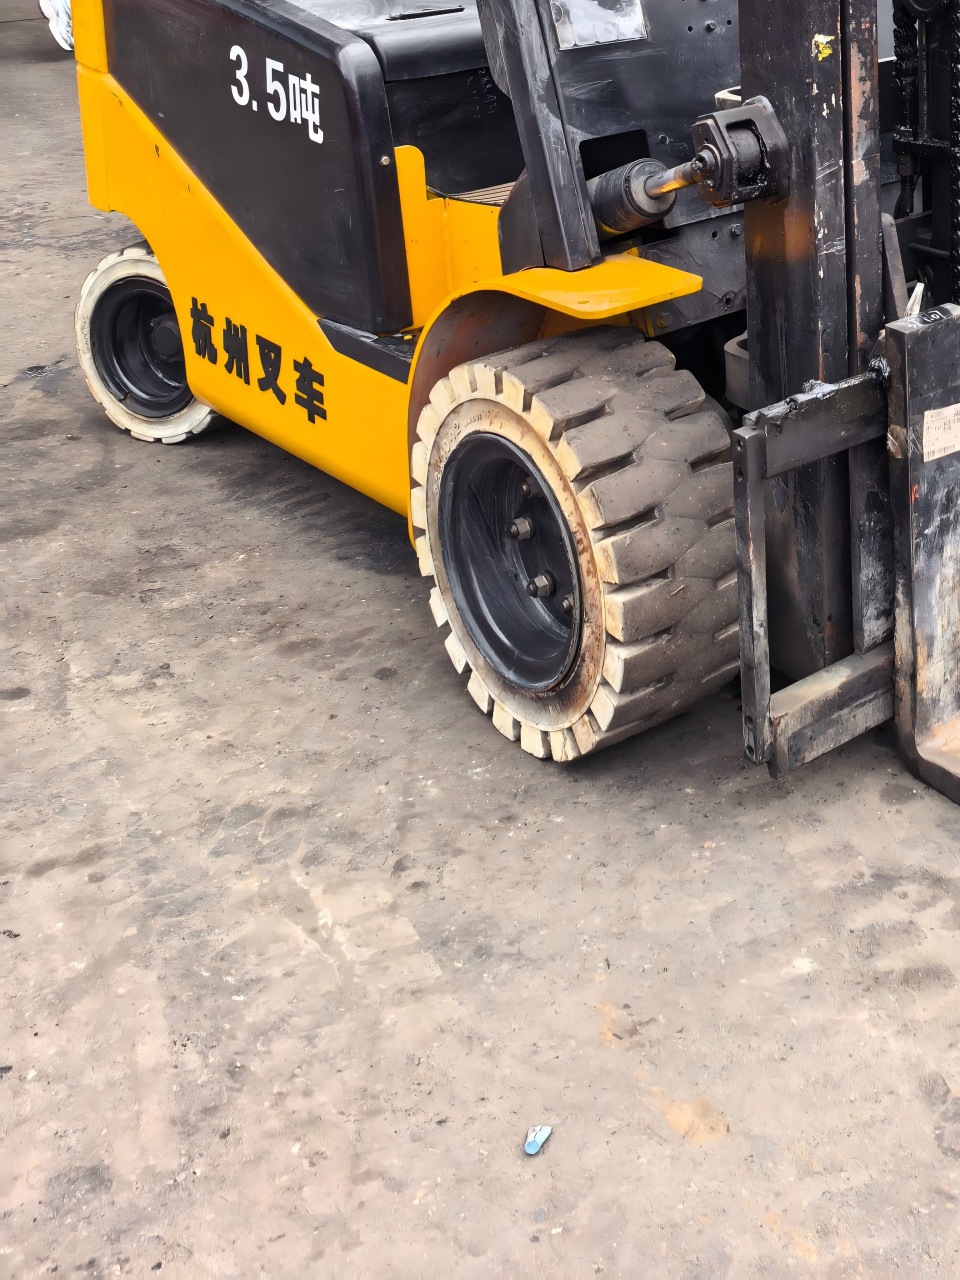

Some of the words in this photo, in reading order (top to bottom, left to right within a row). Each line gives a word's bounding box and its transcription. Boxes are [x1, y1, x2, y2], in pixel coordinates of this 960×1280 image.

[229, 44, 325, 145] 3.5吨
[189, 296, 327, 425] 杭州叉车
